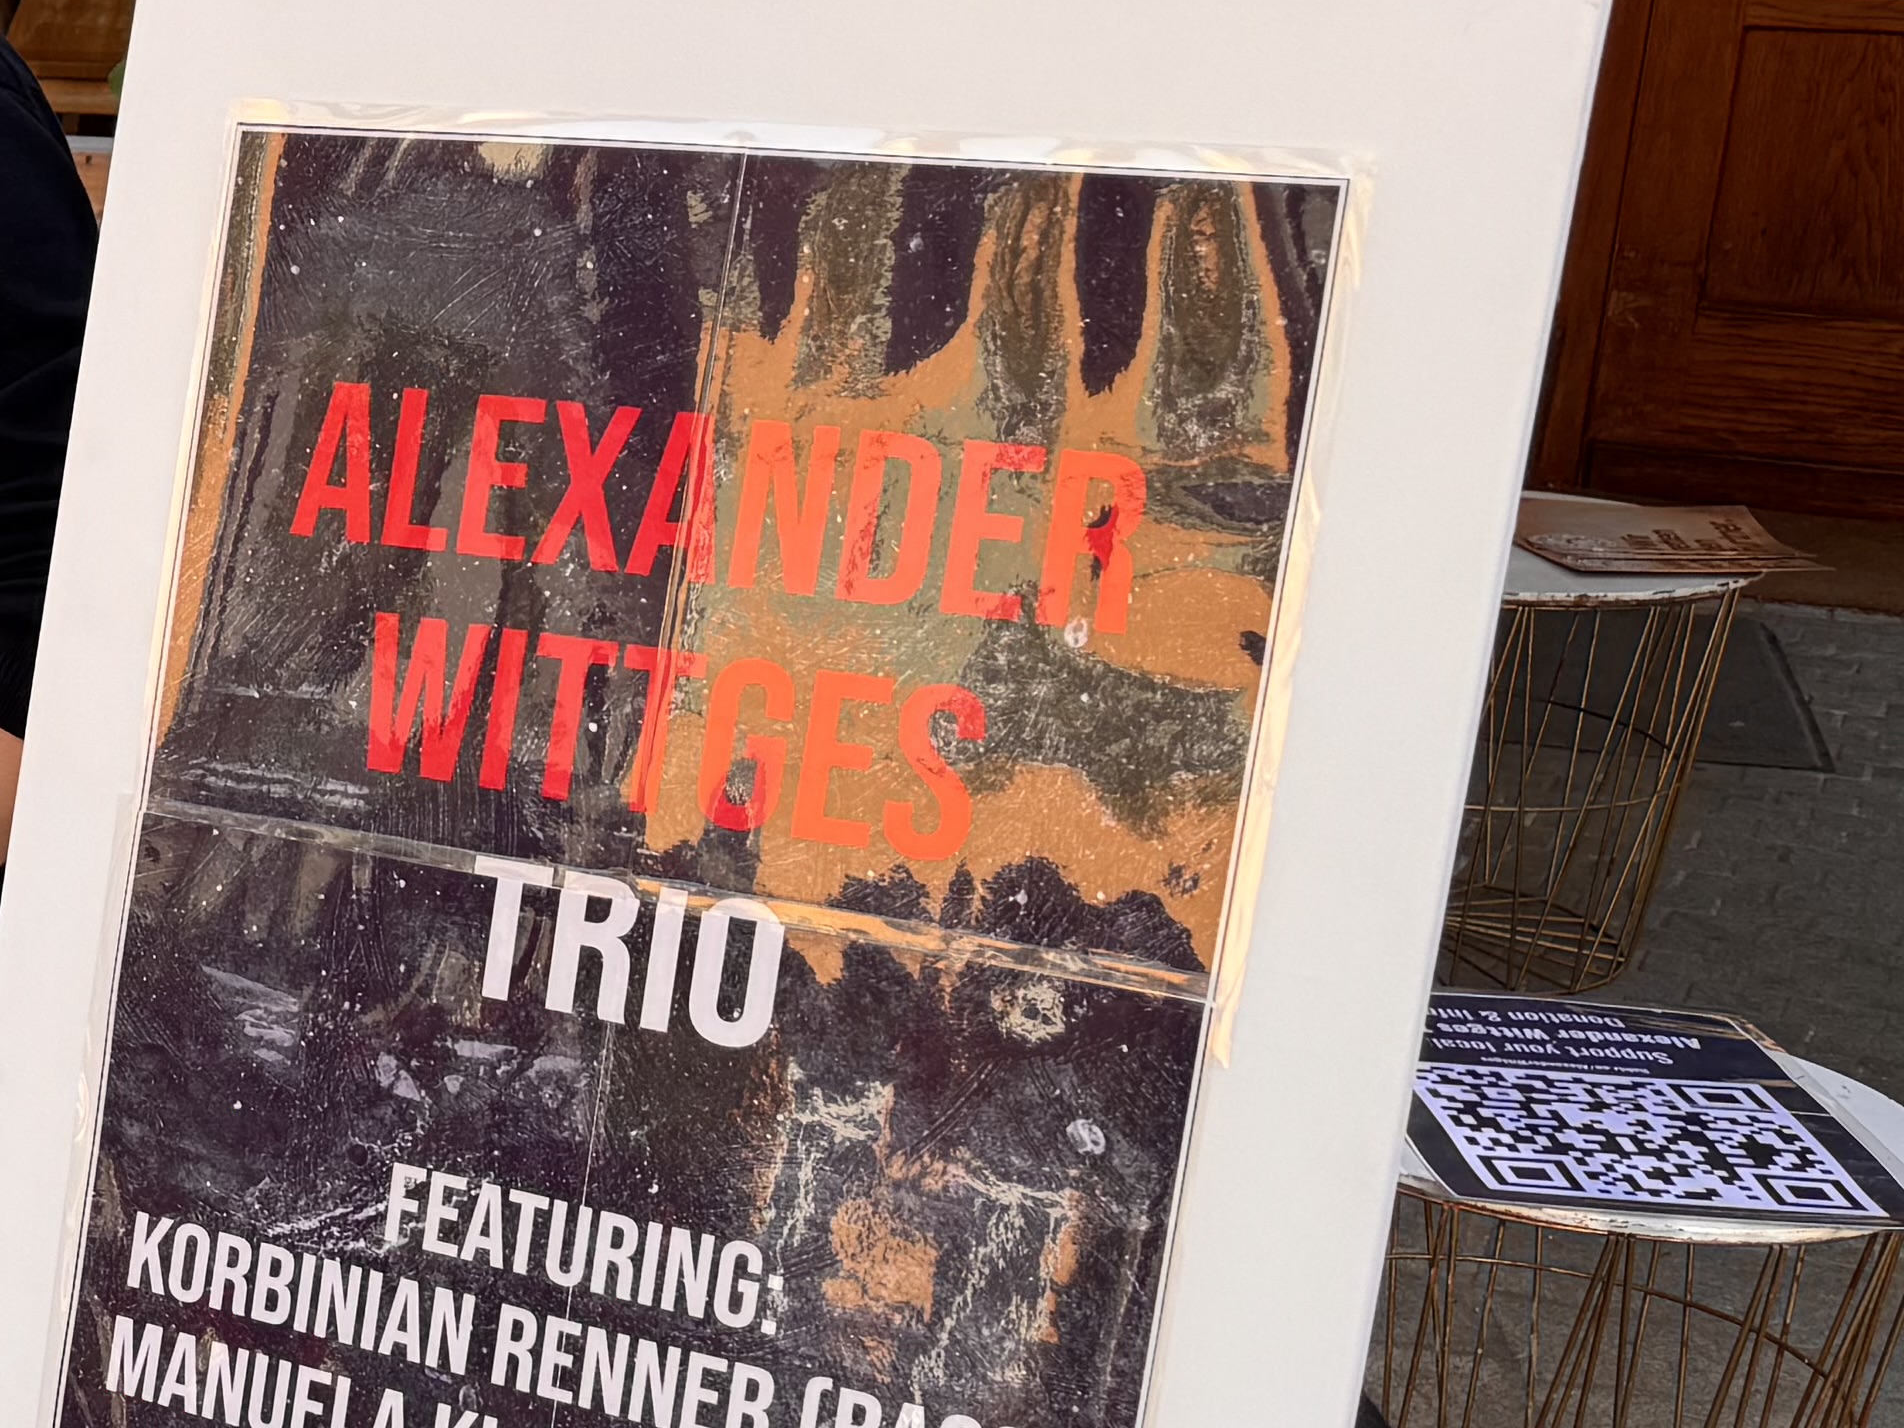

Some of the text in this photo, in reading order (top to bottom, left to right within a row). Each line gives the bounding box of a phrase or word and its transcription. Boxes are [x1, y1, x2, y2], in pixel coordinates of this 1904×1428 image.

[288, 380, 1149, 636] ALEXANDER
[364, 611, 987, 862] WITTGES
[473, 854, 786, 1050] TRIO
[1478, 1010, 1502, 1023] &
[1508, 1010, 1626, 1028] Donation
[1432, 1037, 1496, 1052] local
[1436, 1022, 1701, 1050] Alexander Wittges
[1504, 1040, 1561, 1056] your
[1566, 1045, 1674, 1065] Support
[384, 1162, 786, 1336] FEATURING:
[127, 1210, 475, 1378] KORBINIAN
